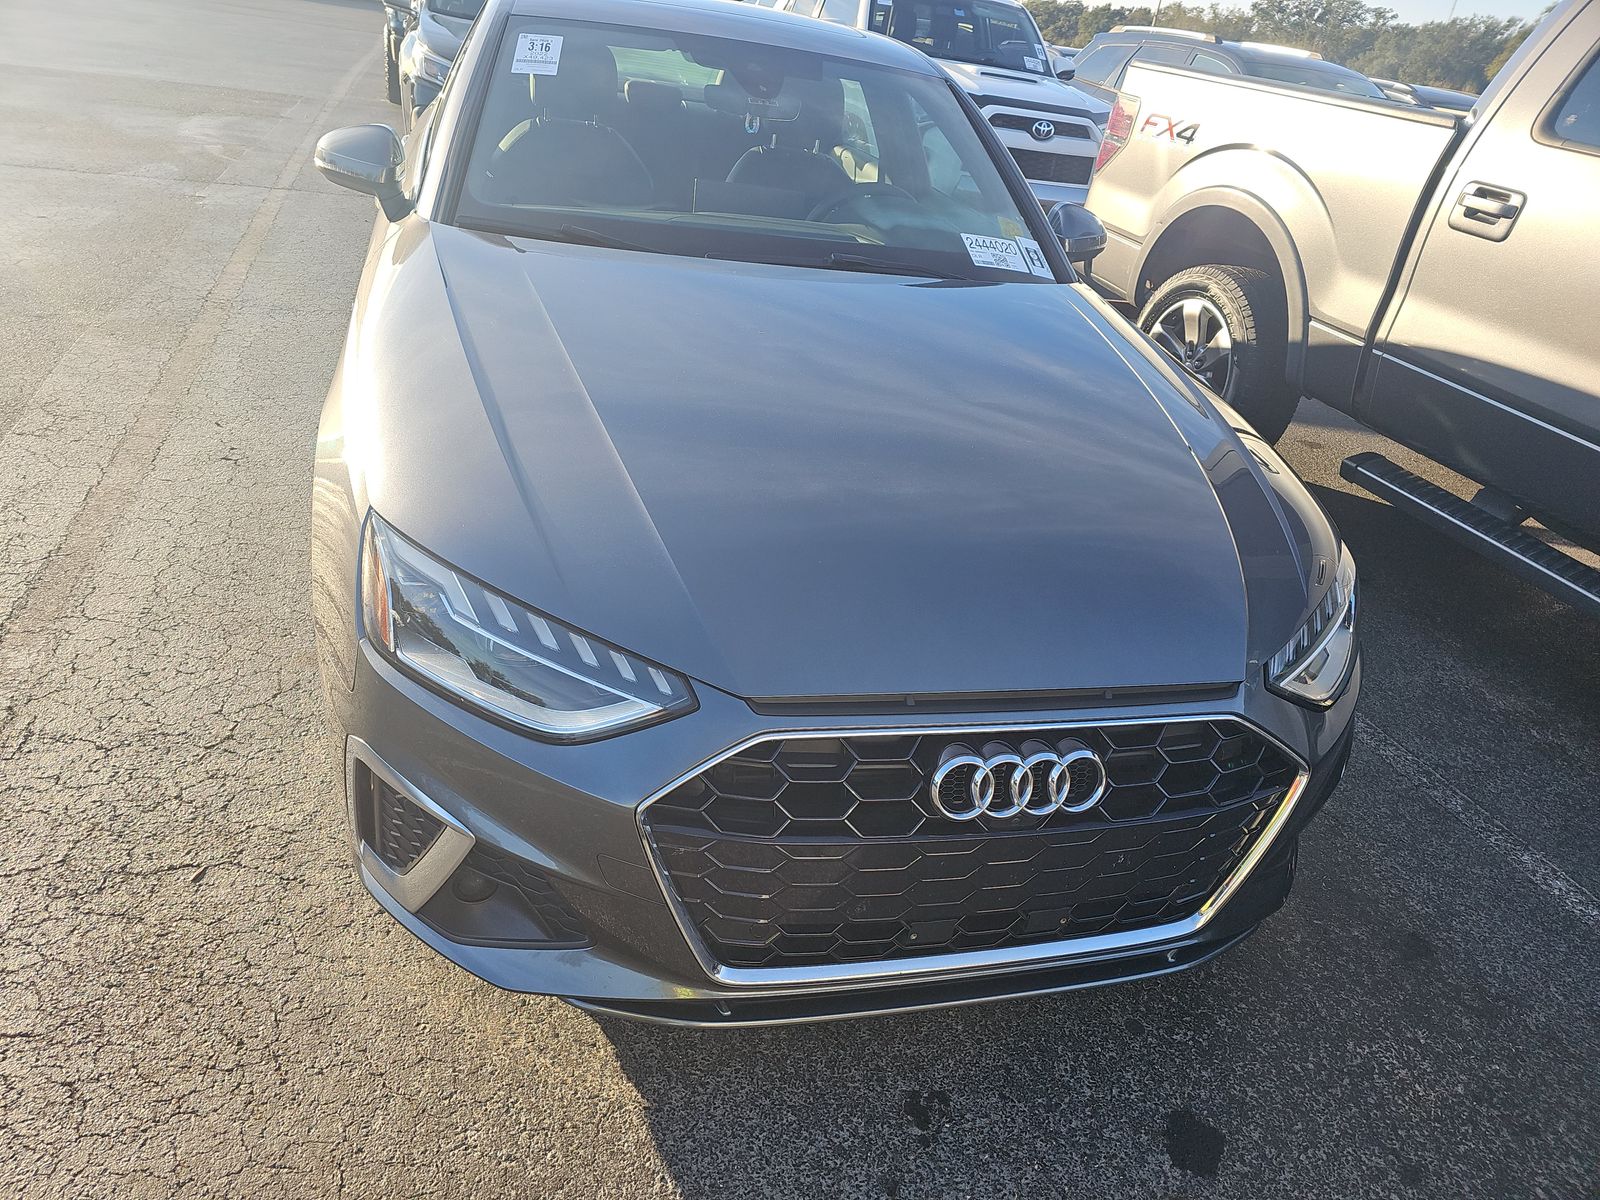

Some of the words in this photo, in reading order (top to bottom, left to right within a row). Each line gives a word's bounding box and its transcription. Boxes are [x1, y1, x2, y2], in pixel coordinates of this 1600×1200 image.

[528, 41, 551, 52] 3:16
[1140, 113, 1200, 144] FX4
[965, 236, 1017, 256] 2444020
